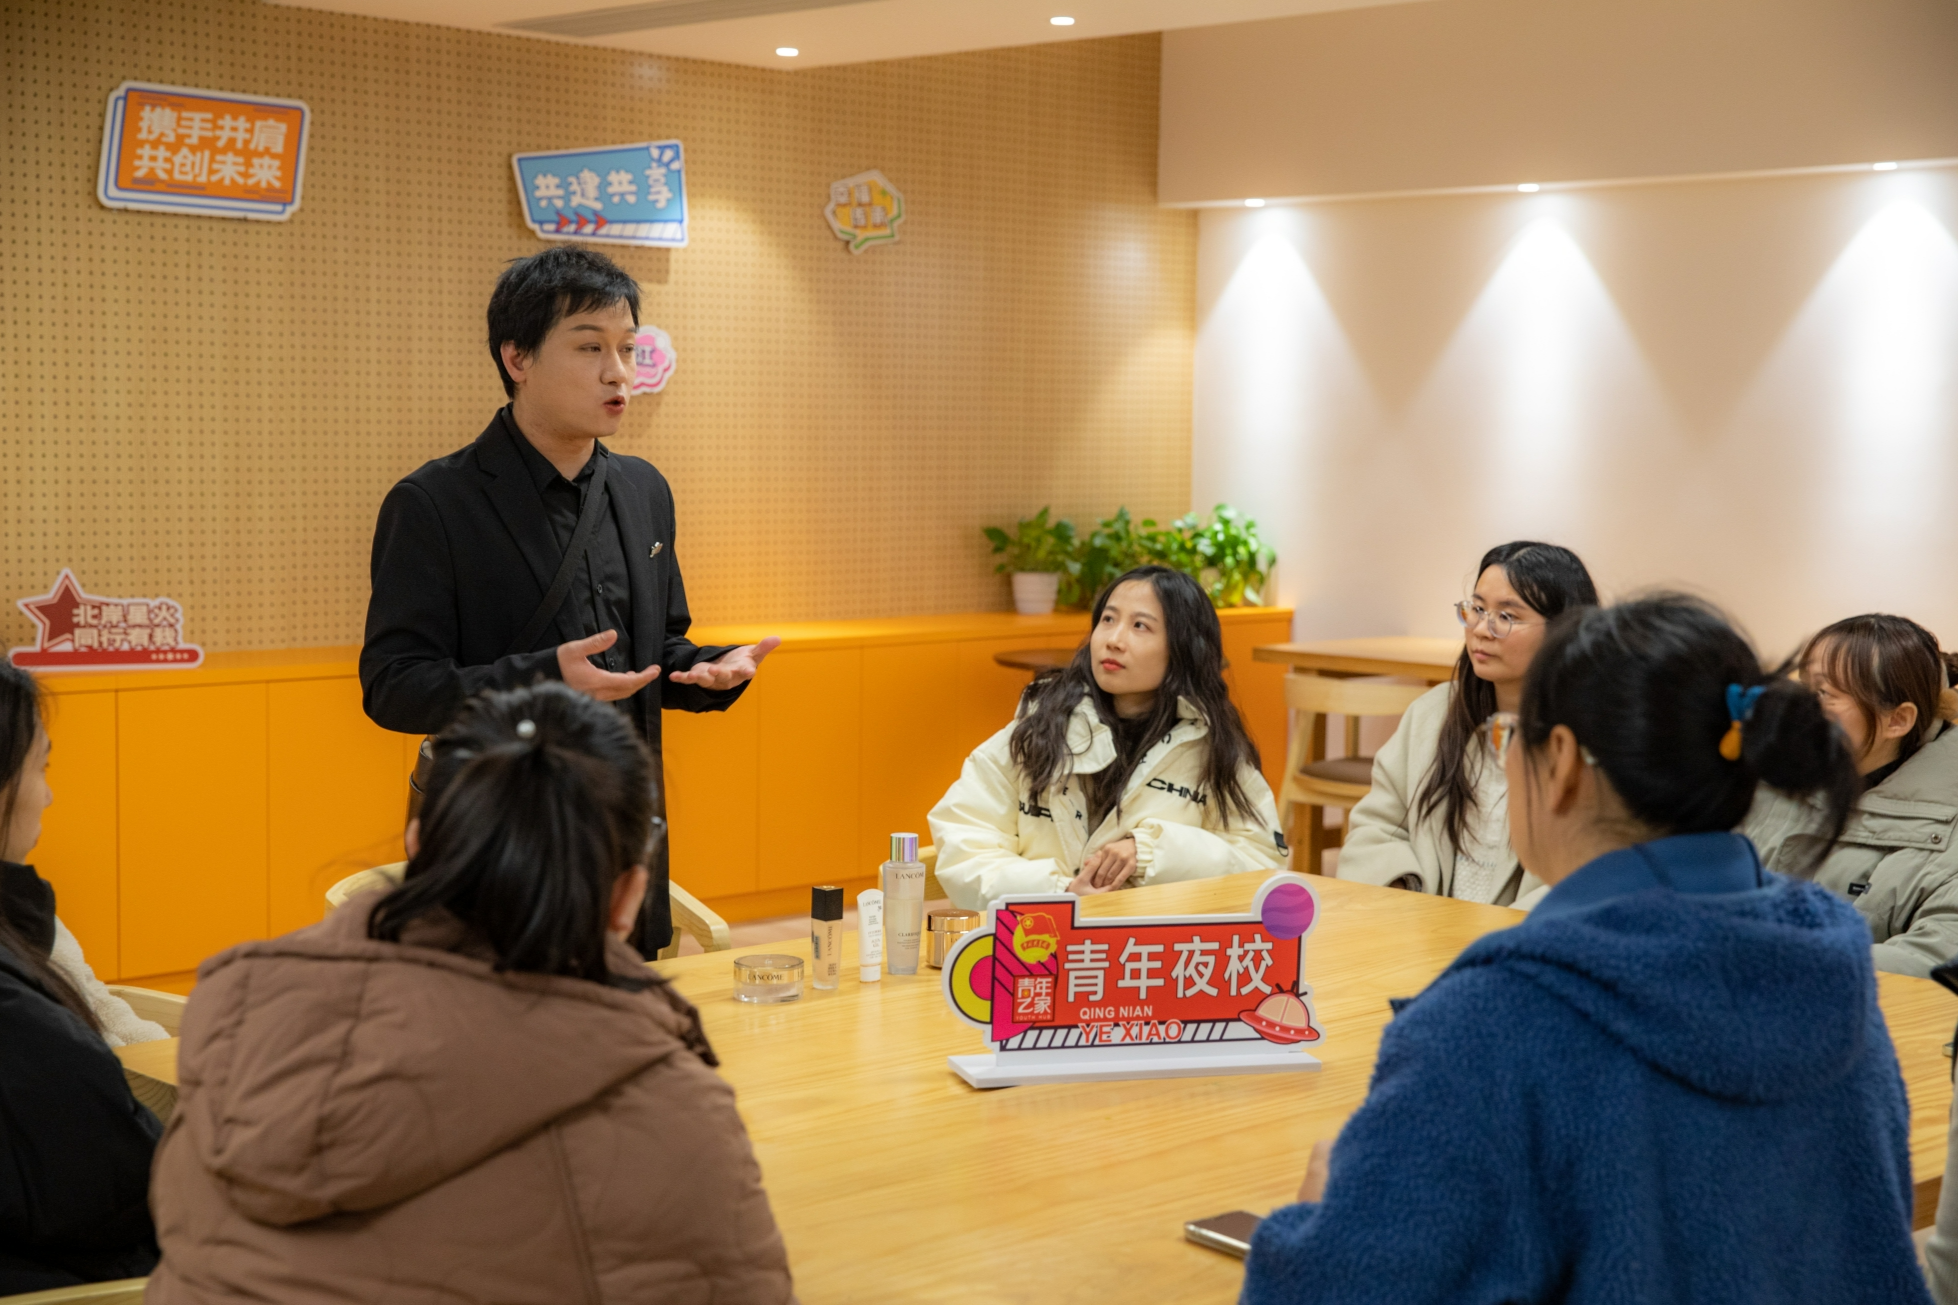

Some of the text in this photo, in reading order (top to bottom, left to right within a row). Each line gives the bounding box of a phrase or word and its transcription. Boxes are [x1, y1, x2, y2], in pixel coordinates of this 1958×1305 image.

[133, 145, 282, 189] 共创未来
[533, 163, 673, 211] 共建共享
[72, 603, 179, 626] 北岸星火
[73, 626, 178, 650] 同行有我
[1063, 933, 1274, 1003] 青年夜校
[1017, 977, 1052, 998] 青年
[1017, 996, 1051, 1014] 之家
[1079, 1005, 1153, 1020] QING NIAN
[1078, 1018, 1184, 1044] YE XIAO
